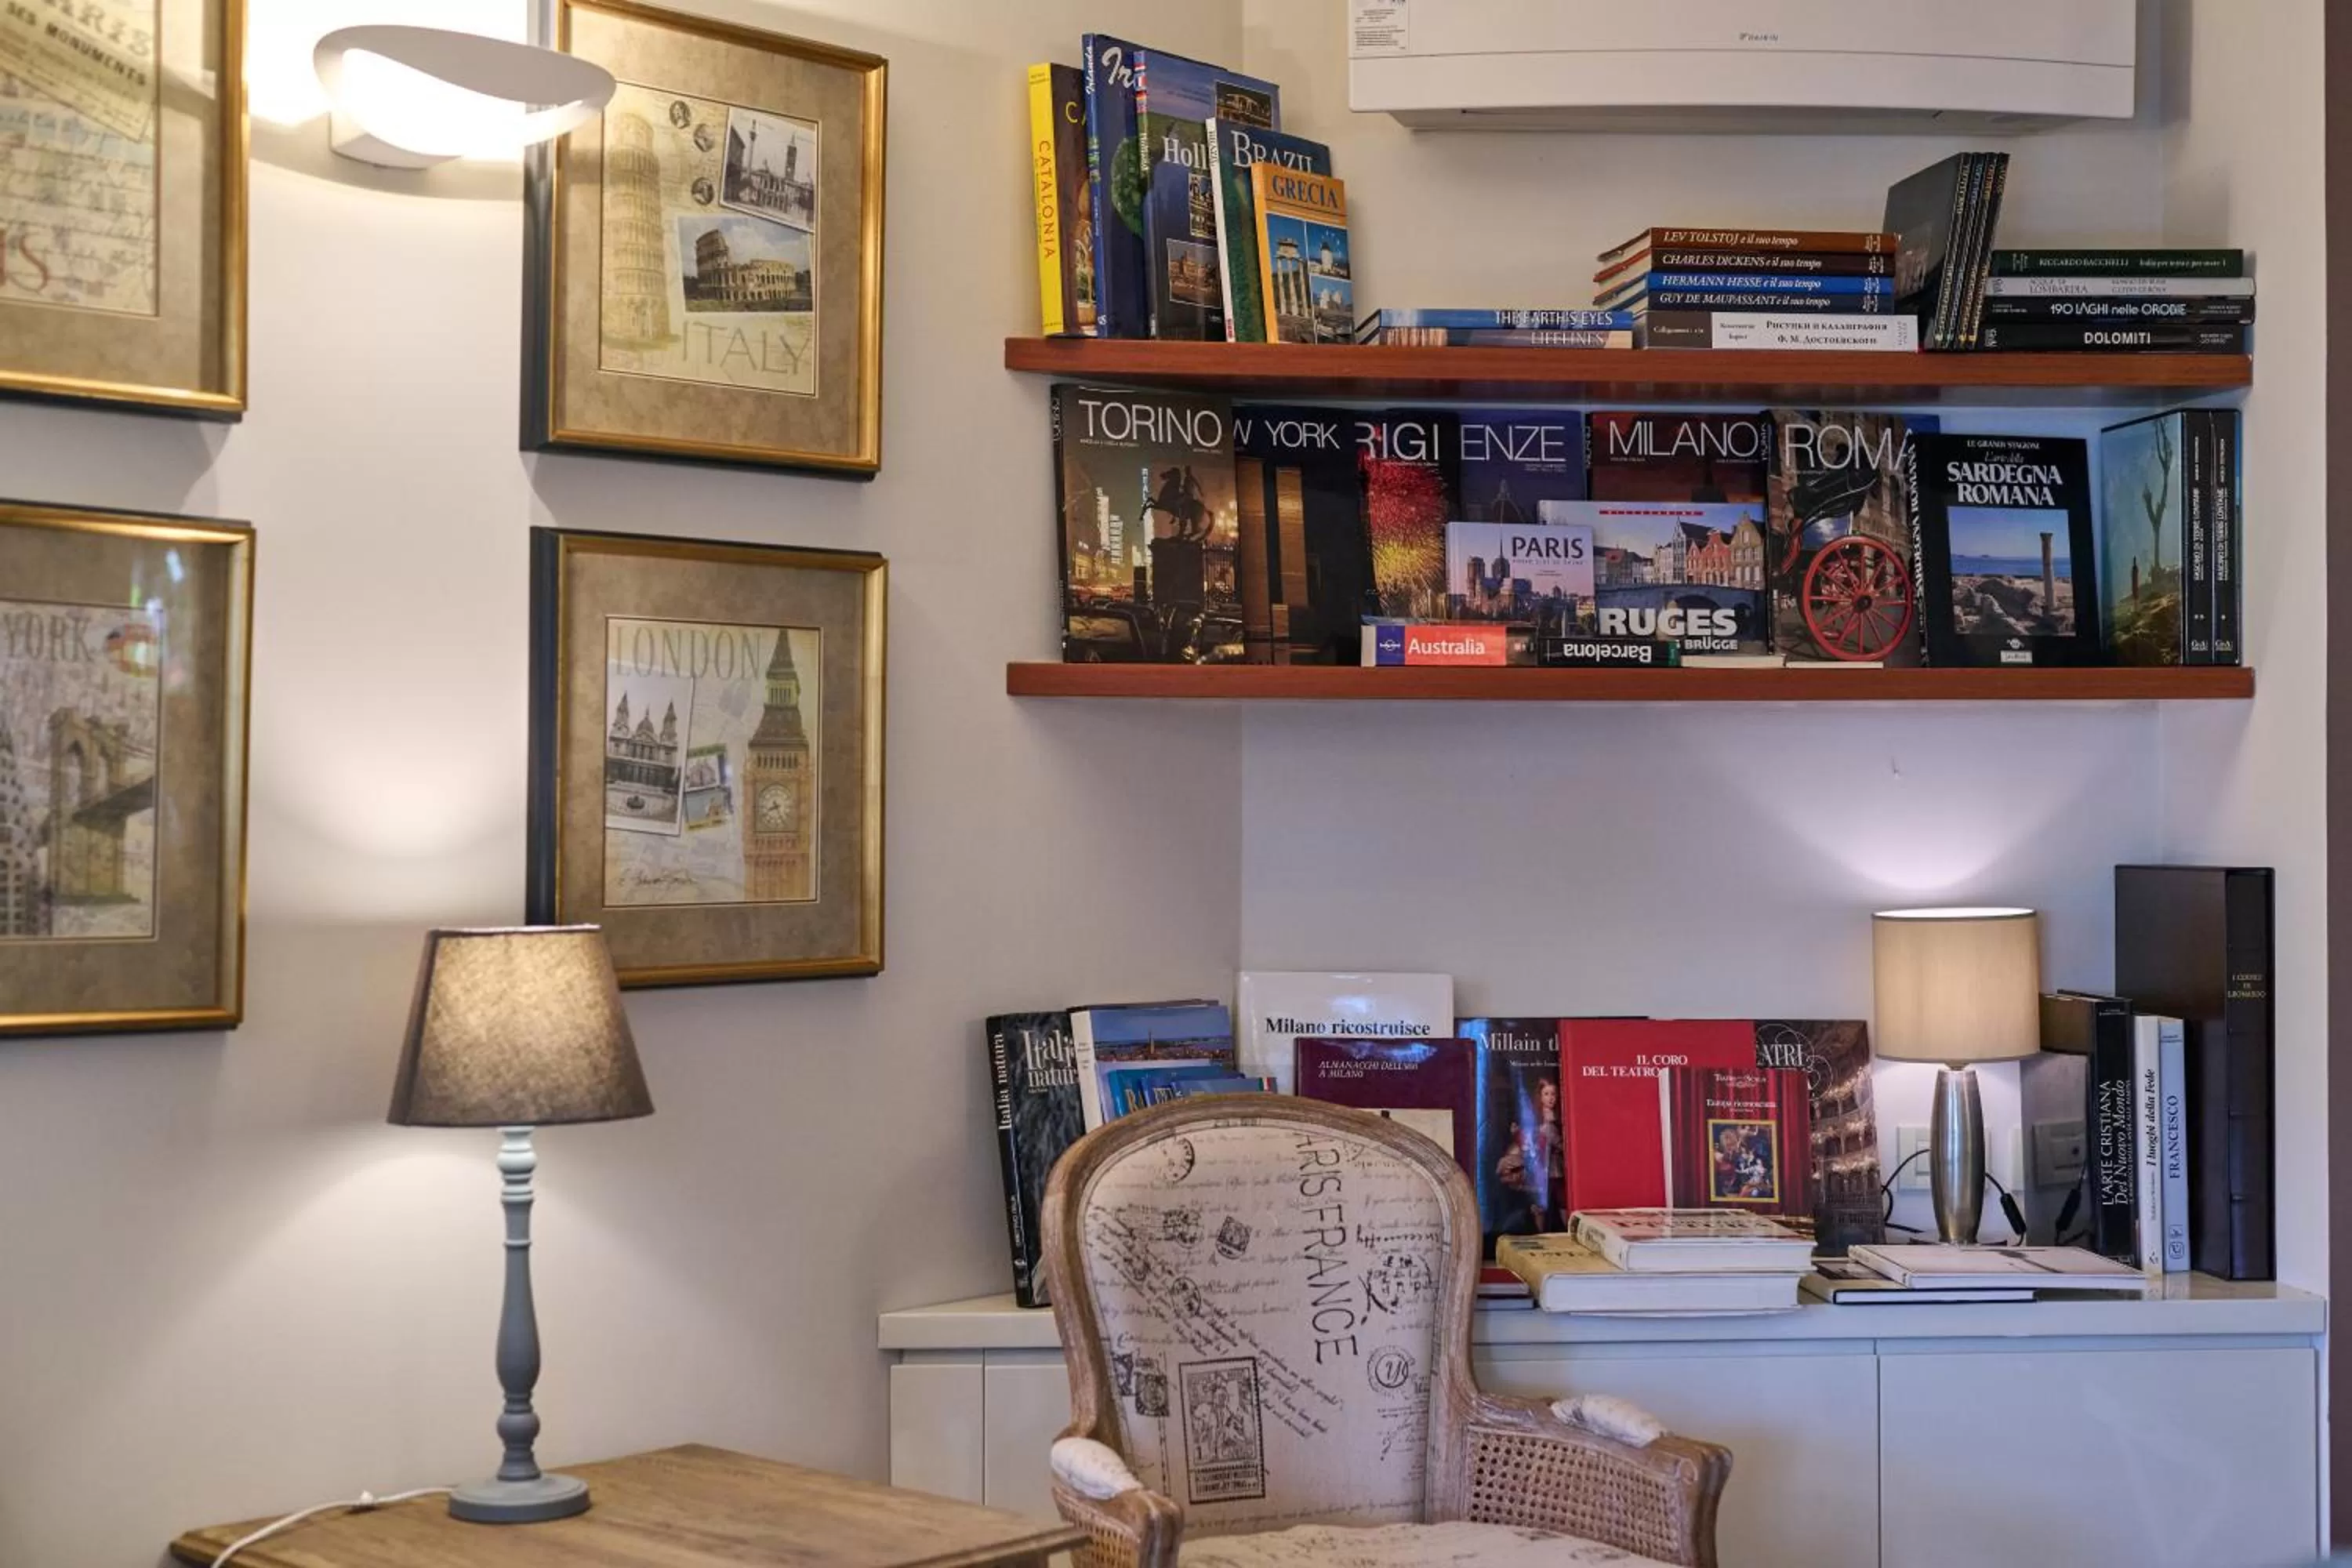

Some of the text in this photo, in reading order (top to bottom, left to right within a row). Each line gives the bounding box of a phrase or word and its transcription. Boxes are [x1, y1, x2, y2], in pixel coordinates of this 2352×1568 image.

[1102, 46, 1136, 89] Ir
[1037, 140, 1055, 259] CATALONIA
[1272, 175, 1339, 209] GRECIA
[1664, 231, 1687, 242] LEV
[1690, 232, 1740, 245] TOLSTOJ
[1747, 233, 1755, 244] il
[1771, 237, 1799, 249] tempo
[1662, 254, 1716, 266] CHARLES
[1717, 256, 1765, 267] DICKENS
[1771, 257, 1779, 267] il
[1796, 258, 1823, 270] tempo
[1662, 275, 1724, 286] HERMANN
[1726, 277, 1762, 287] HESSE
[1769, 278, 1777, 288] il
[1795, 279, 1821, 291] tempo
[1660, 292, 1684, 303] GUY
[1685, 294, 1700, 303] DE
[1702, 294, 1777, 305] MAUPASSANT
[1782, 296, 1790, 306] il
[1806, 297, 1831, 309] tempo
[2050, 303, 2074, 314] 190
[2075, 301, 2108, 314] LAGHI
[1495, 310, 1521, 325] THE
[1581, 311, 1613, 326] EYES
[682, 321, 810, 376] ITALY
[2084, 332, 2151, 344] DOLOMITI
[1078, 400, 1222, 447] TORINO
[1265, 420, 1340, 449] YORK
[1610, 420, 1759, 457] MILANO
[1947, 461, 2063, 485] SARDEGNA
[1957, 483, 2056, 506] ROMANA
[1512, 536, 1584, 559] PARIS
[1599, 608, 1738, 637] RUGES
[3, 612, 94, 663] YORK
[1408, 637, 1486, 655] Australia
[615, 626, 762, 681] LONDON
[1563, 643, 1652, 663] Barcelona
[1266, 1017, 1431, 1036] Milano ricostruisce
[1636, 1054, 1688, 1065] IL CORO
[1756, 1044, 1804, 1066] ATRI
[993, 1032, 1012, 1131] Italia natura
[1027, 1067, 1079, 1087] natur
[1319, 1069, 1326, 1078] A
[1582, 1066, 1661, 1077] DEL TEATRO
[2144, 1069, 2155, 1095] Fede
[2144, 1095, 2155, 1123] della
[2099, 1080, 2114, 1206] L'ARTE CRISTIANA
[2111, 1079, 2129, 1205] Del Nuovo Mondo
[2166, 1094, 2180, 1179] FRANCESCO
[1301, 1203, 1359, 1366] FRANCE
